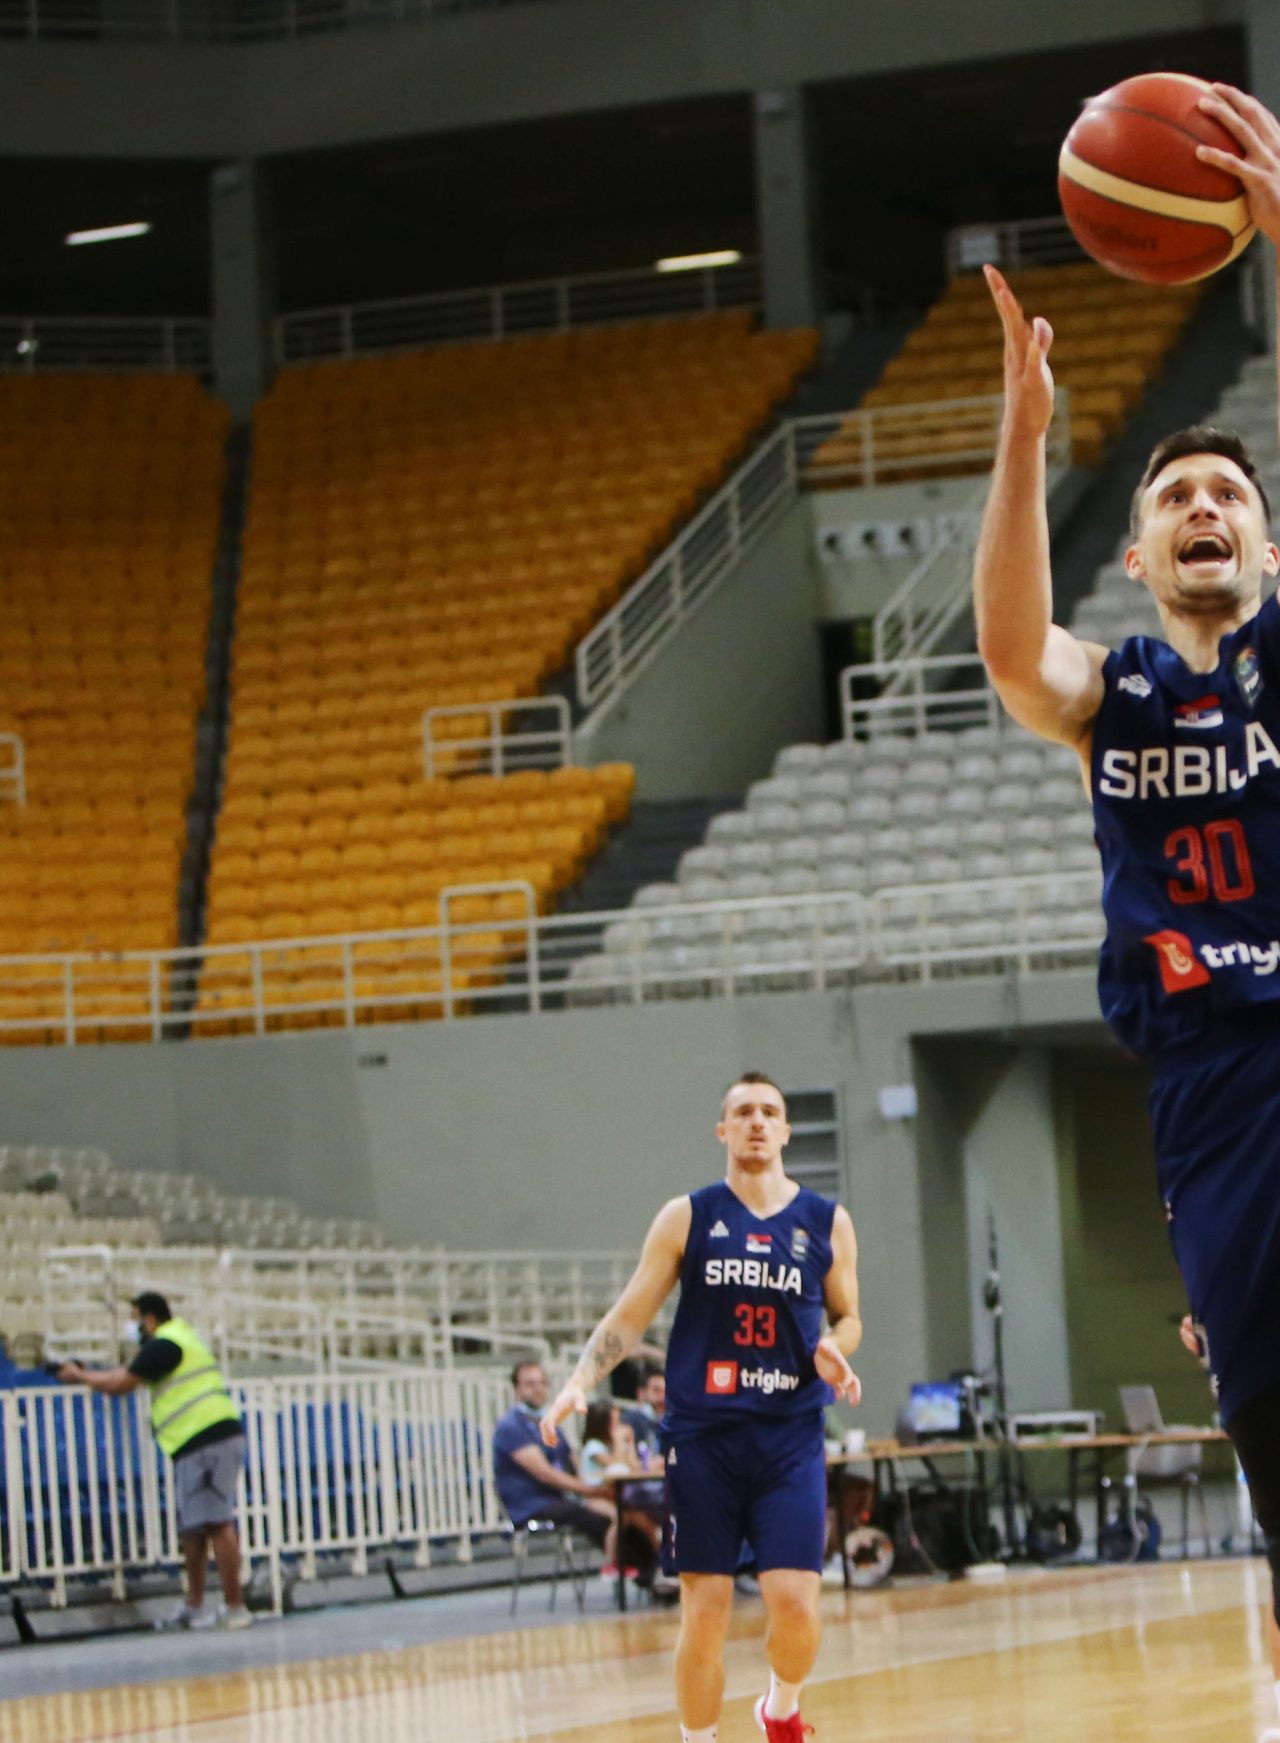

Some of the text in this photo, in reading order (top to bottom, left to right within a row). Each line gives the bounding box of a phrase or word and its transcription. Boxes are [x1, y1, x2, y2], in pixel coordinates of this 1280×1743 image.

[1164, 818, 1256, 905] 30
[705, 1258, 802, 1295] SRBIJA
[734, 1302, 776, 1348] 33
[740, 1367, 800, 1394] triglav
